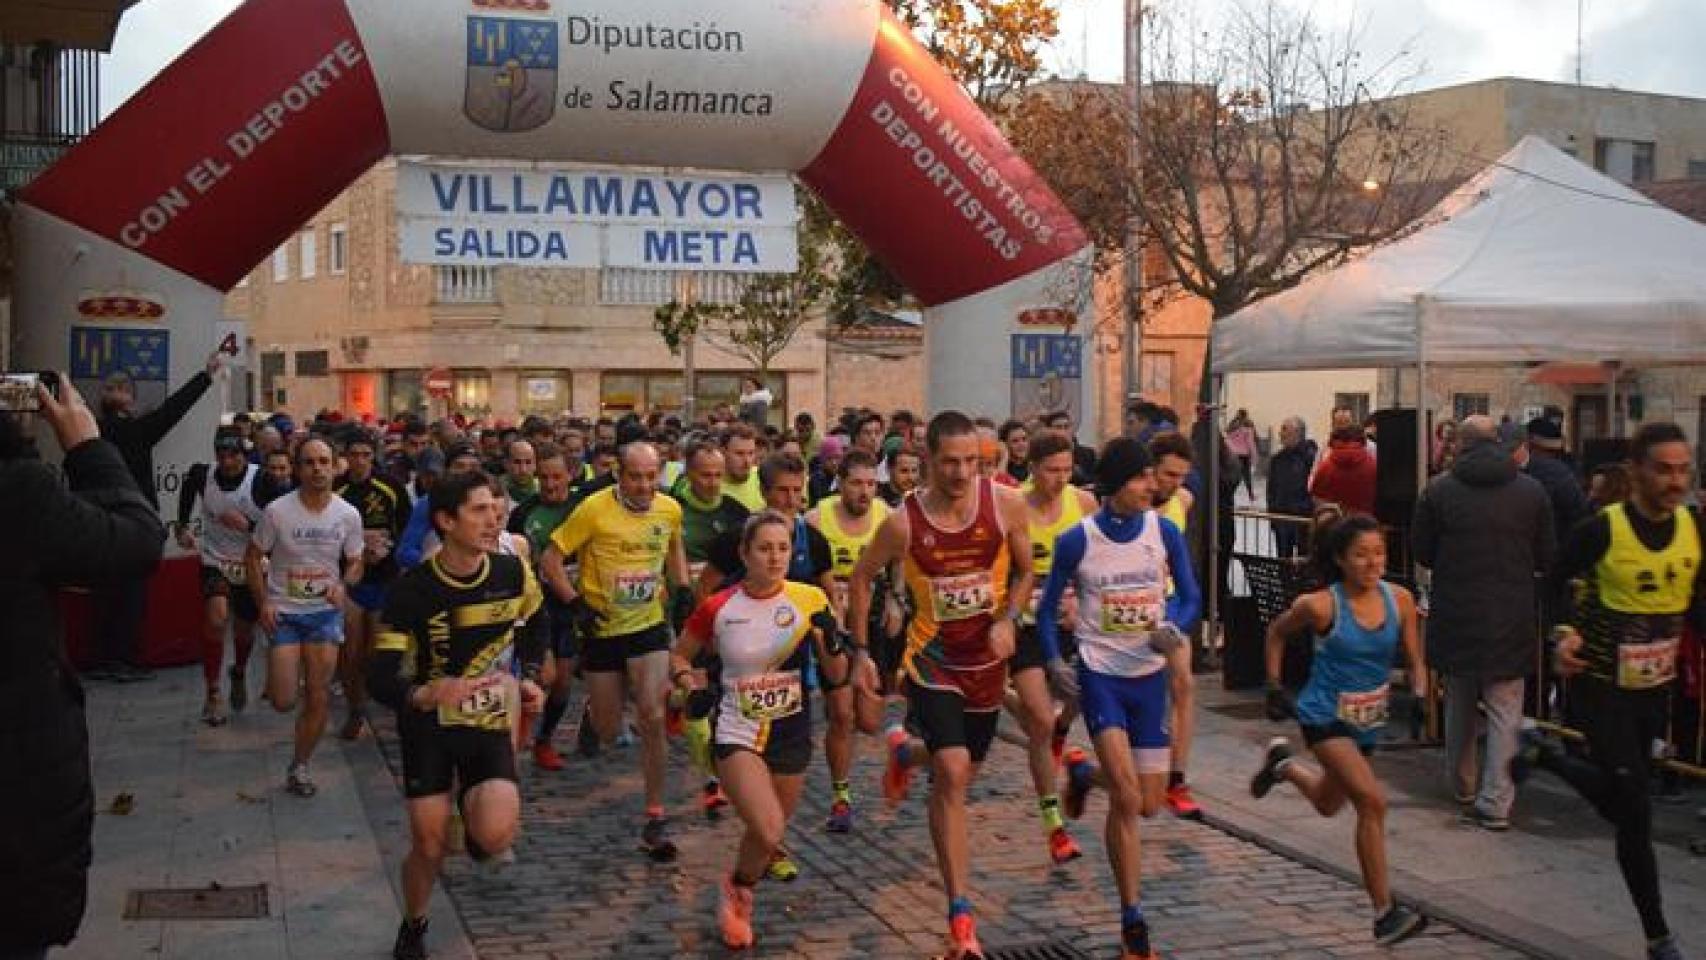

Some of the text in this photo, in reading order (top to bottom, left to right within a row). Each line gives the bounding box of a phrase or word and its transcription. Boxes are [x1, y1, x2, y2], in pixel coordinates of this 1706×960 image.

[568, 16, 743, 53] Diputación
[565, 80, 773, 117] de Salamanca
[119, 37, 366, 250] CON EL DEPORTE
[889, 67, 1053, 244] CON NUESTROS
[431, 172, 763, 219] VILLAMAYOR
[871, 100, 1021, 260] DEPORTISTAS
[434, 227, 759, 264] SALIDA META
[751, 687, 789, 711] 207
